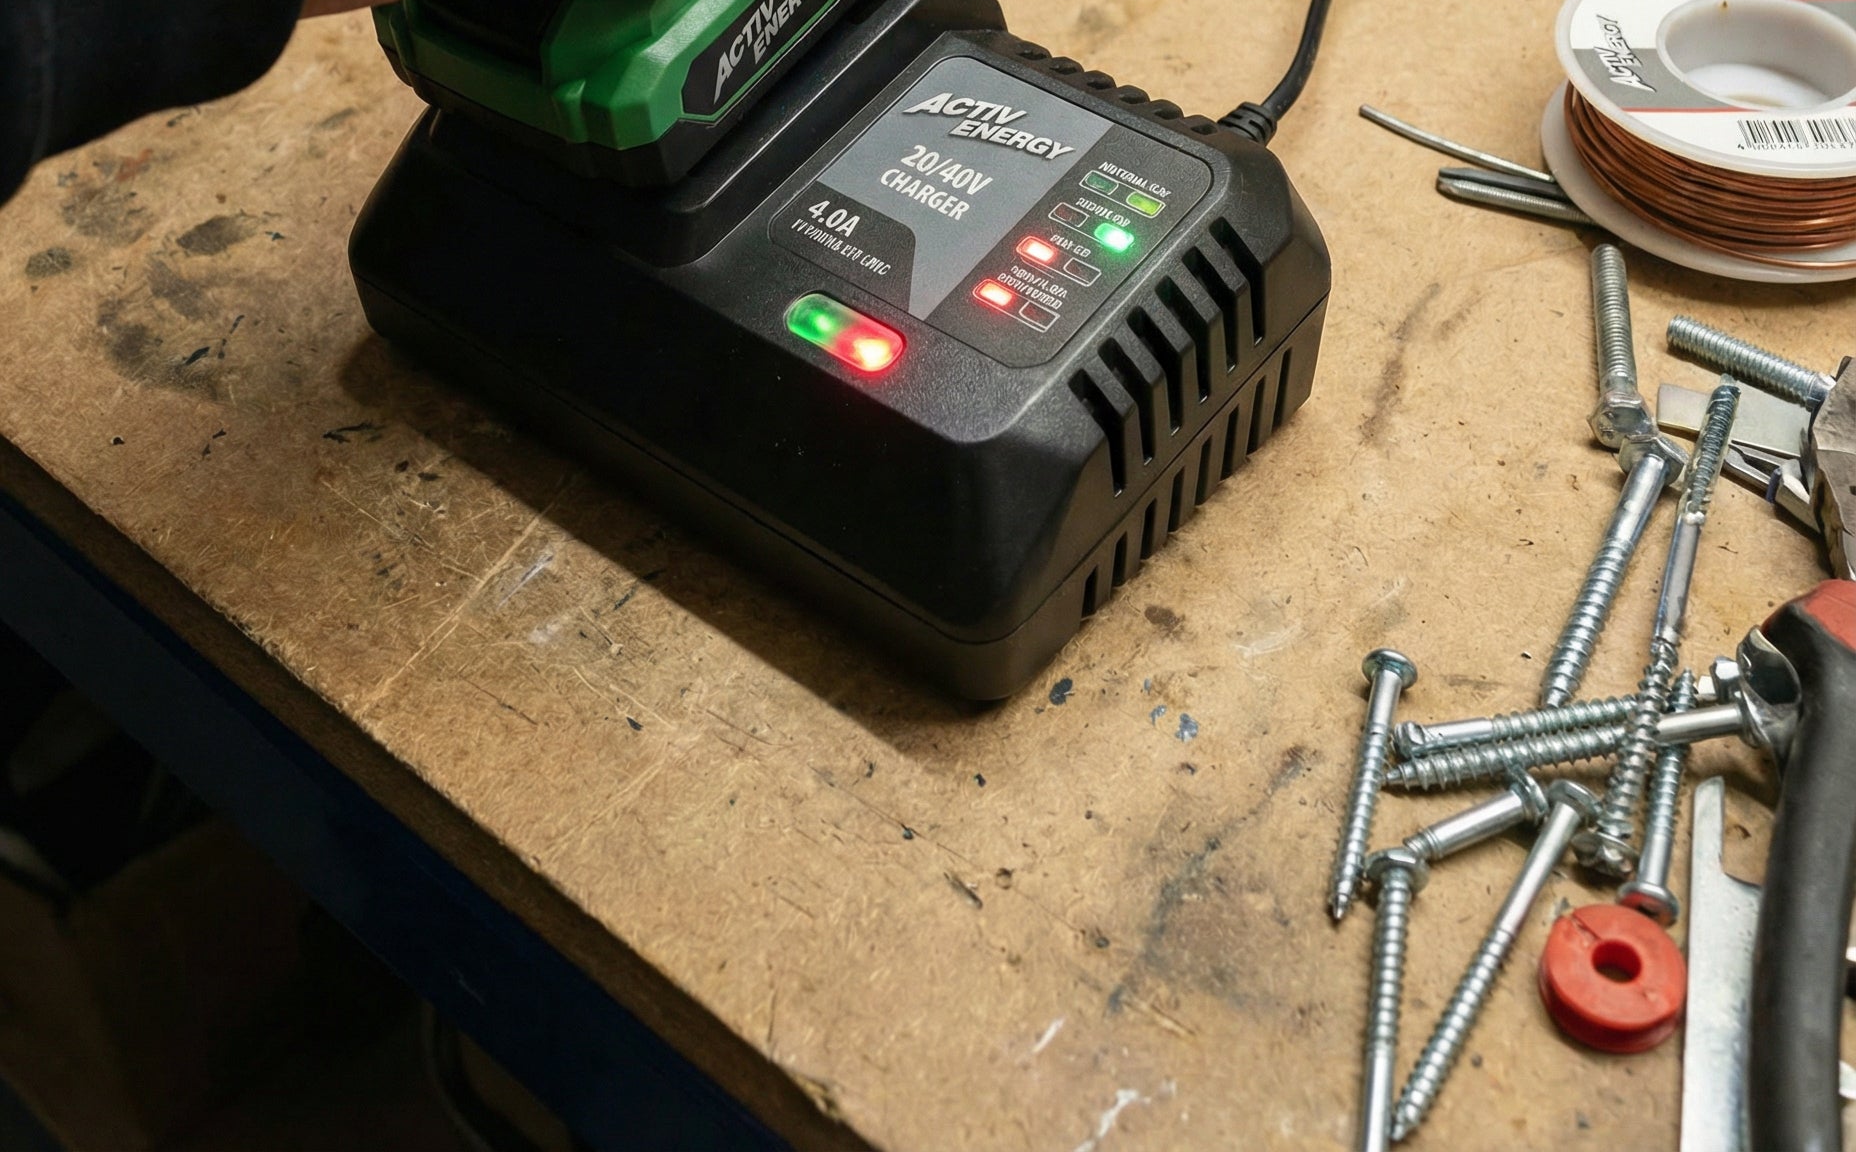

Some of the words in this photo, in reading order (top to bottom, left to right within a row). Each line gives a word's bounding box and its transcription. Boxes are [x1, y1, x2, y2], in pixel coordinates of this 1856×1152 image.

[902, 92, 1028, 125] ACTIV
[949, 119, 1077, 160] ENERGY
[900, 144, 994, 196] 20/40V
[880, 168, 970, 221] CHARGER
[808, 200, 861, 237] 4.0A
